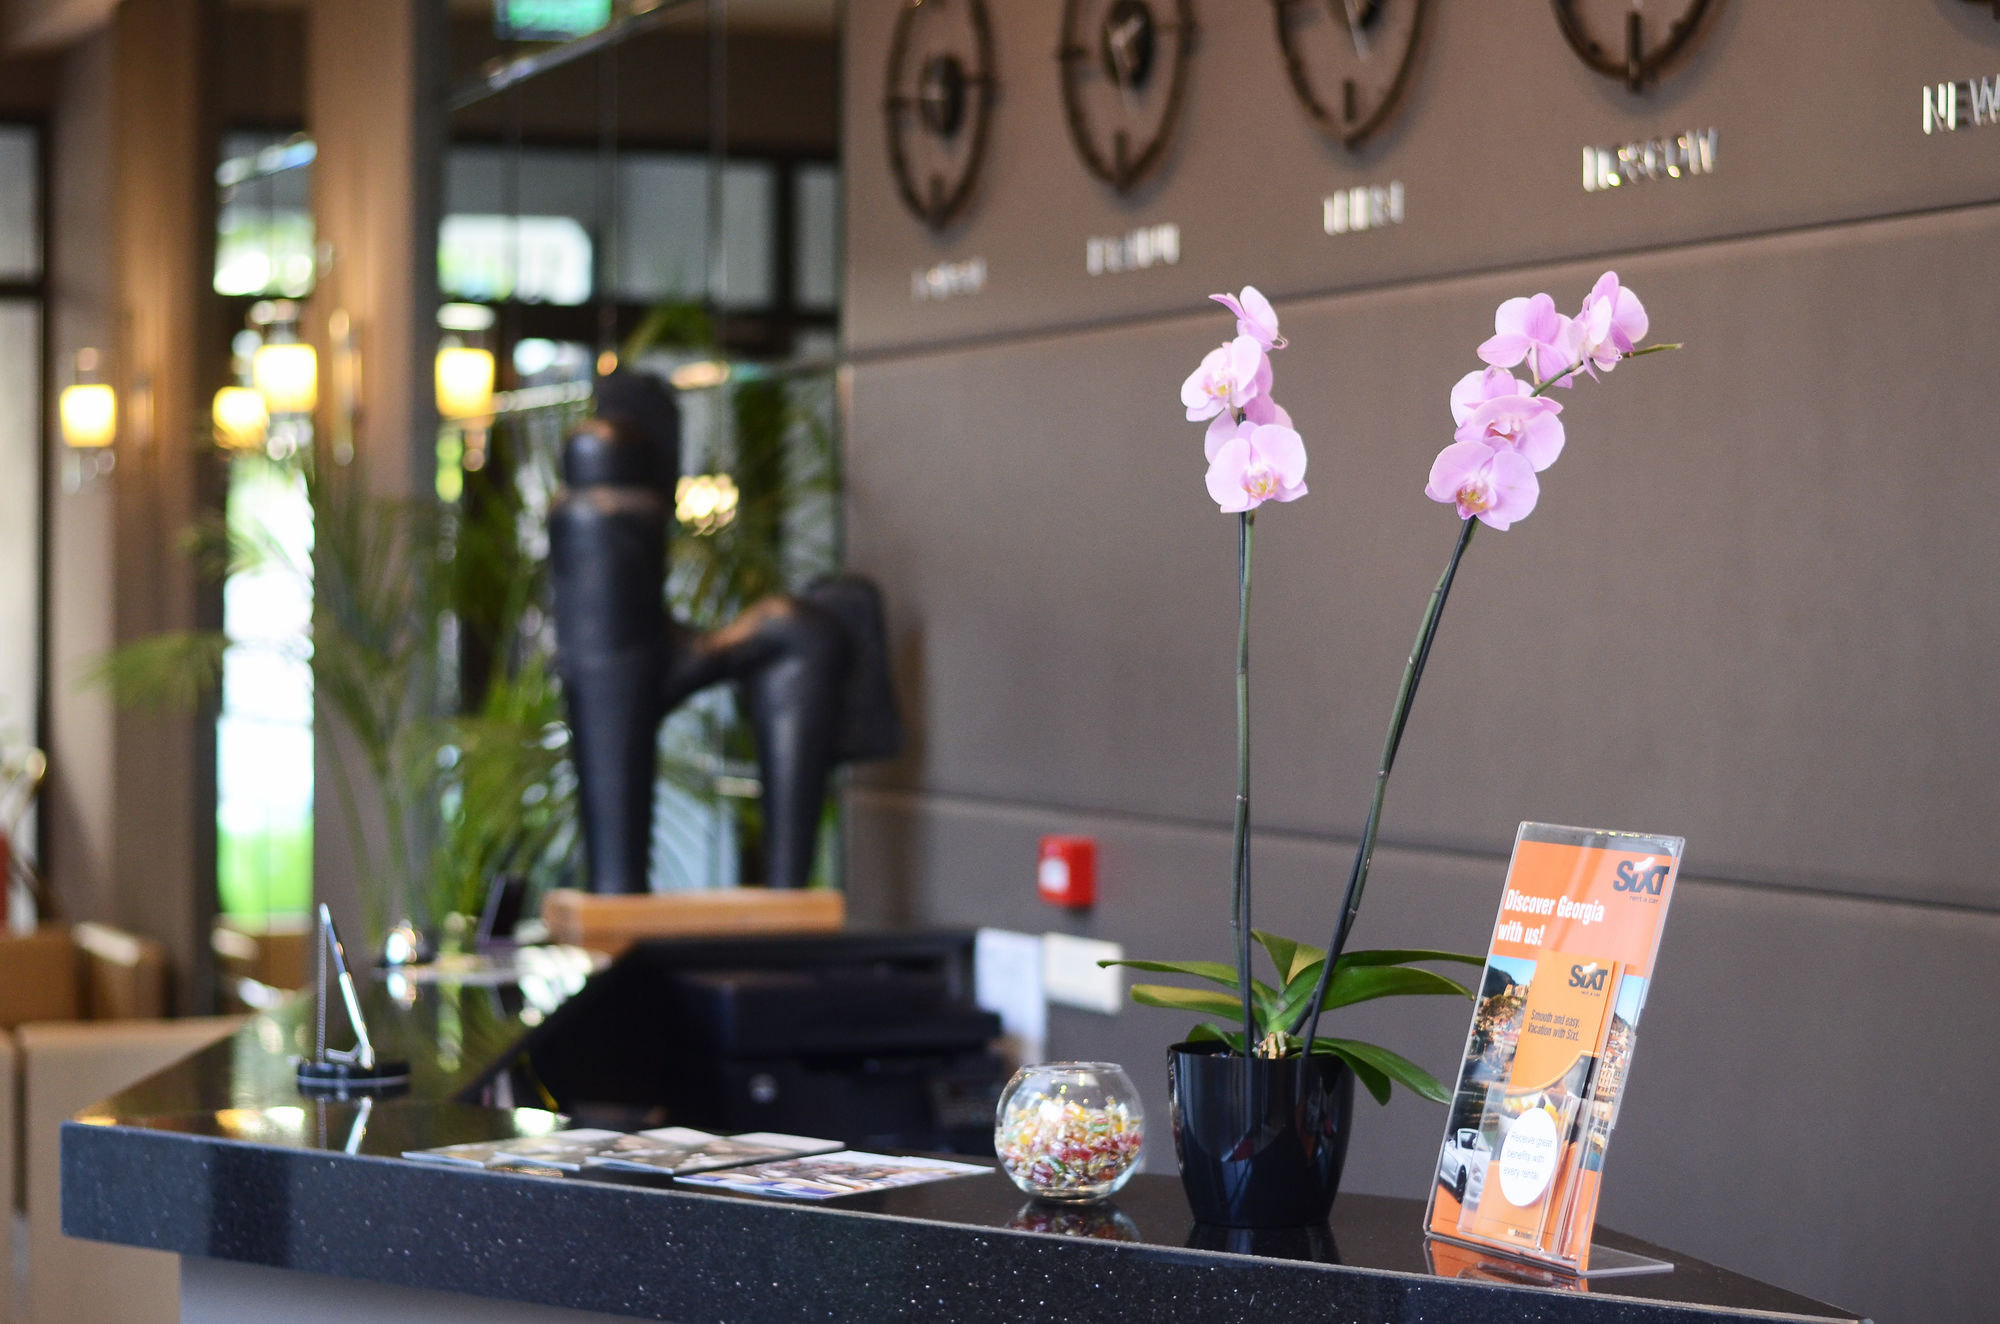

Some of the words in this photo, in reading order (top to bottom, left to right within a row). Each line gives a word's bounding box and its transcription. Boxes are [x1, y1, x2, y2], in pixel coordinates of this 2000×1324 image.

[1504, 889, 1556, 916] Discover
[1556, 896, 1605, 925] Georgia
[1497, 920, 1523, 942] with
[1524, 925, 1546, 946] us!
